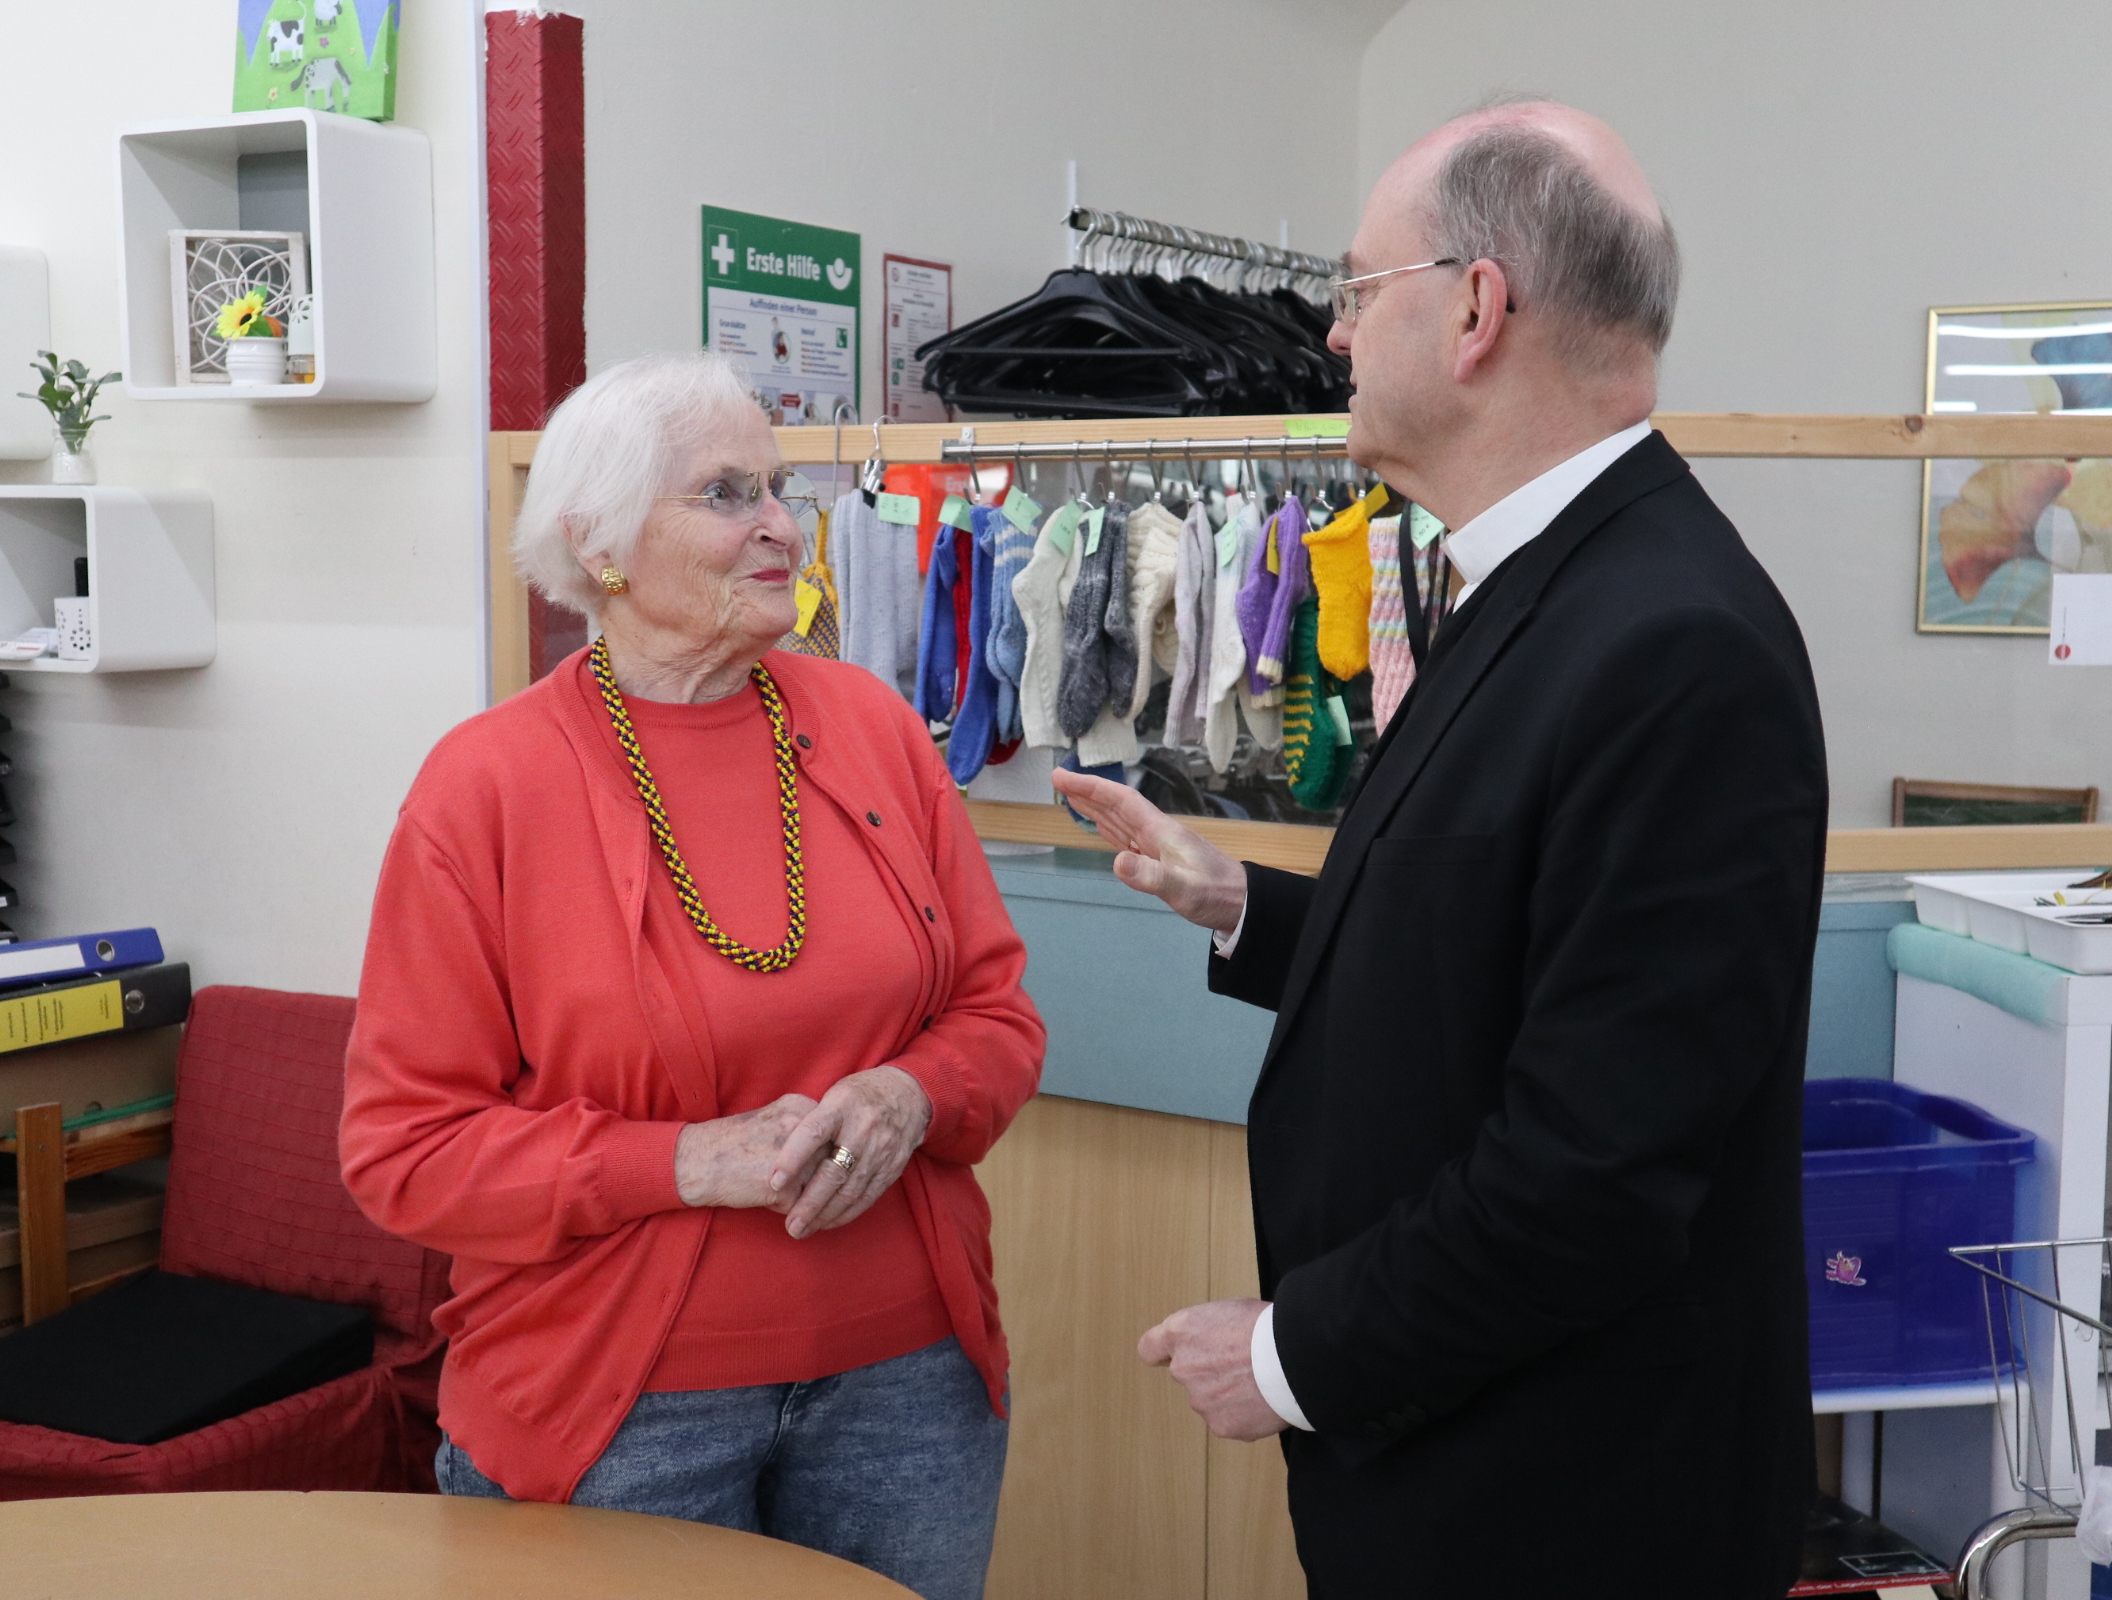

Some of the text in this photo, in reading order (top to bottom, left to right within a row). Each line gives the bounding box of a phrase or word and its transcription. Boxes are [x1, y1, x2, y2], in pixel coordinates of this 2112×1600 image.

[746, 247, 821, 281] Erste Hilfe
[749, 297, 817, 316] Auffinden einer Person
